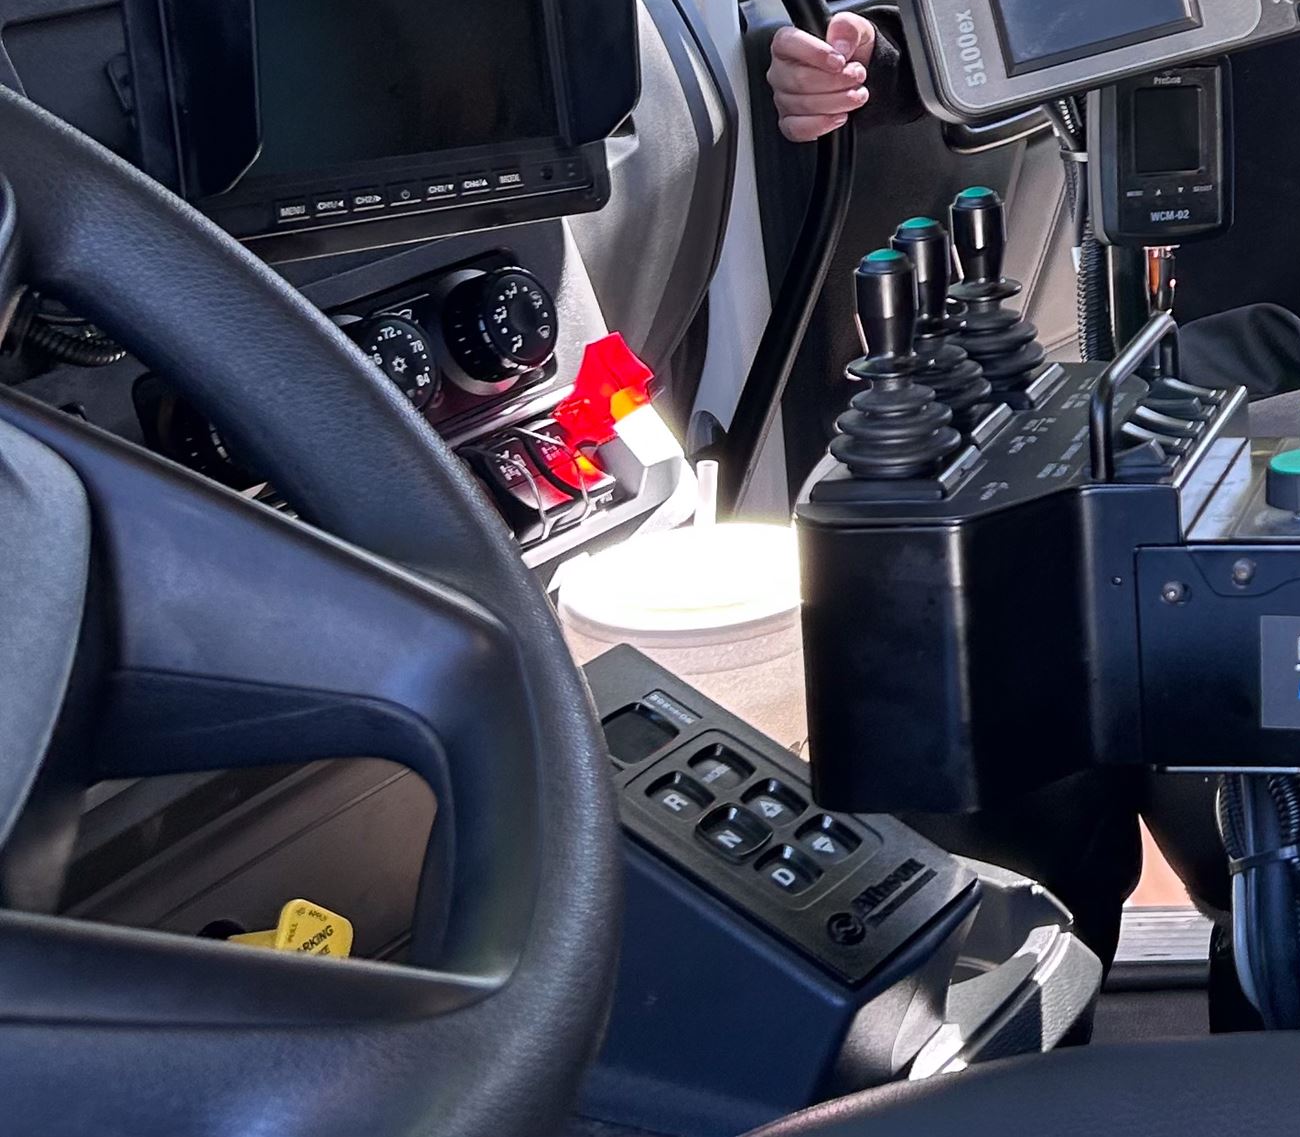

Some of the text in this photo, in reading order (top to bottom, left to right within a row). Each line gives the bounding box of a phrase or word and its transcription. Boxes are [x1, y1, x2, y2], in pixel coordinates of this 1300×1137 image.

[955, 8, 987, 87] 5100ex
[1150, 209, 1190, 222] WCM-02
[380, 326, 397, 340] 72
[415, 372, 431, 387] 84
[662, 793, 688, 812] R
[717, 829, 743, 849] N
[771, 867, 796, 887] D
